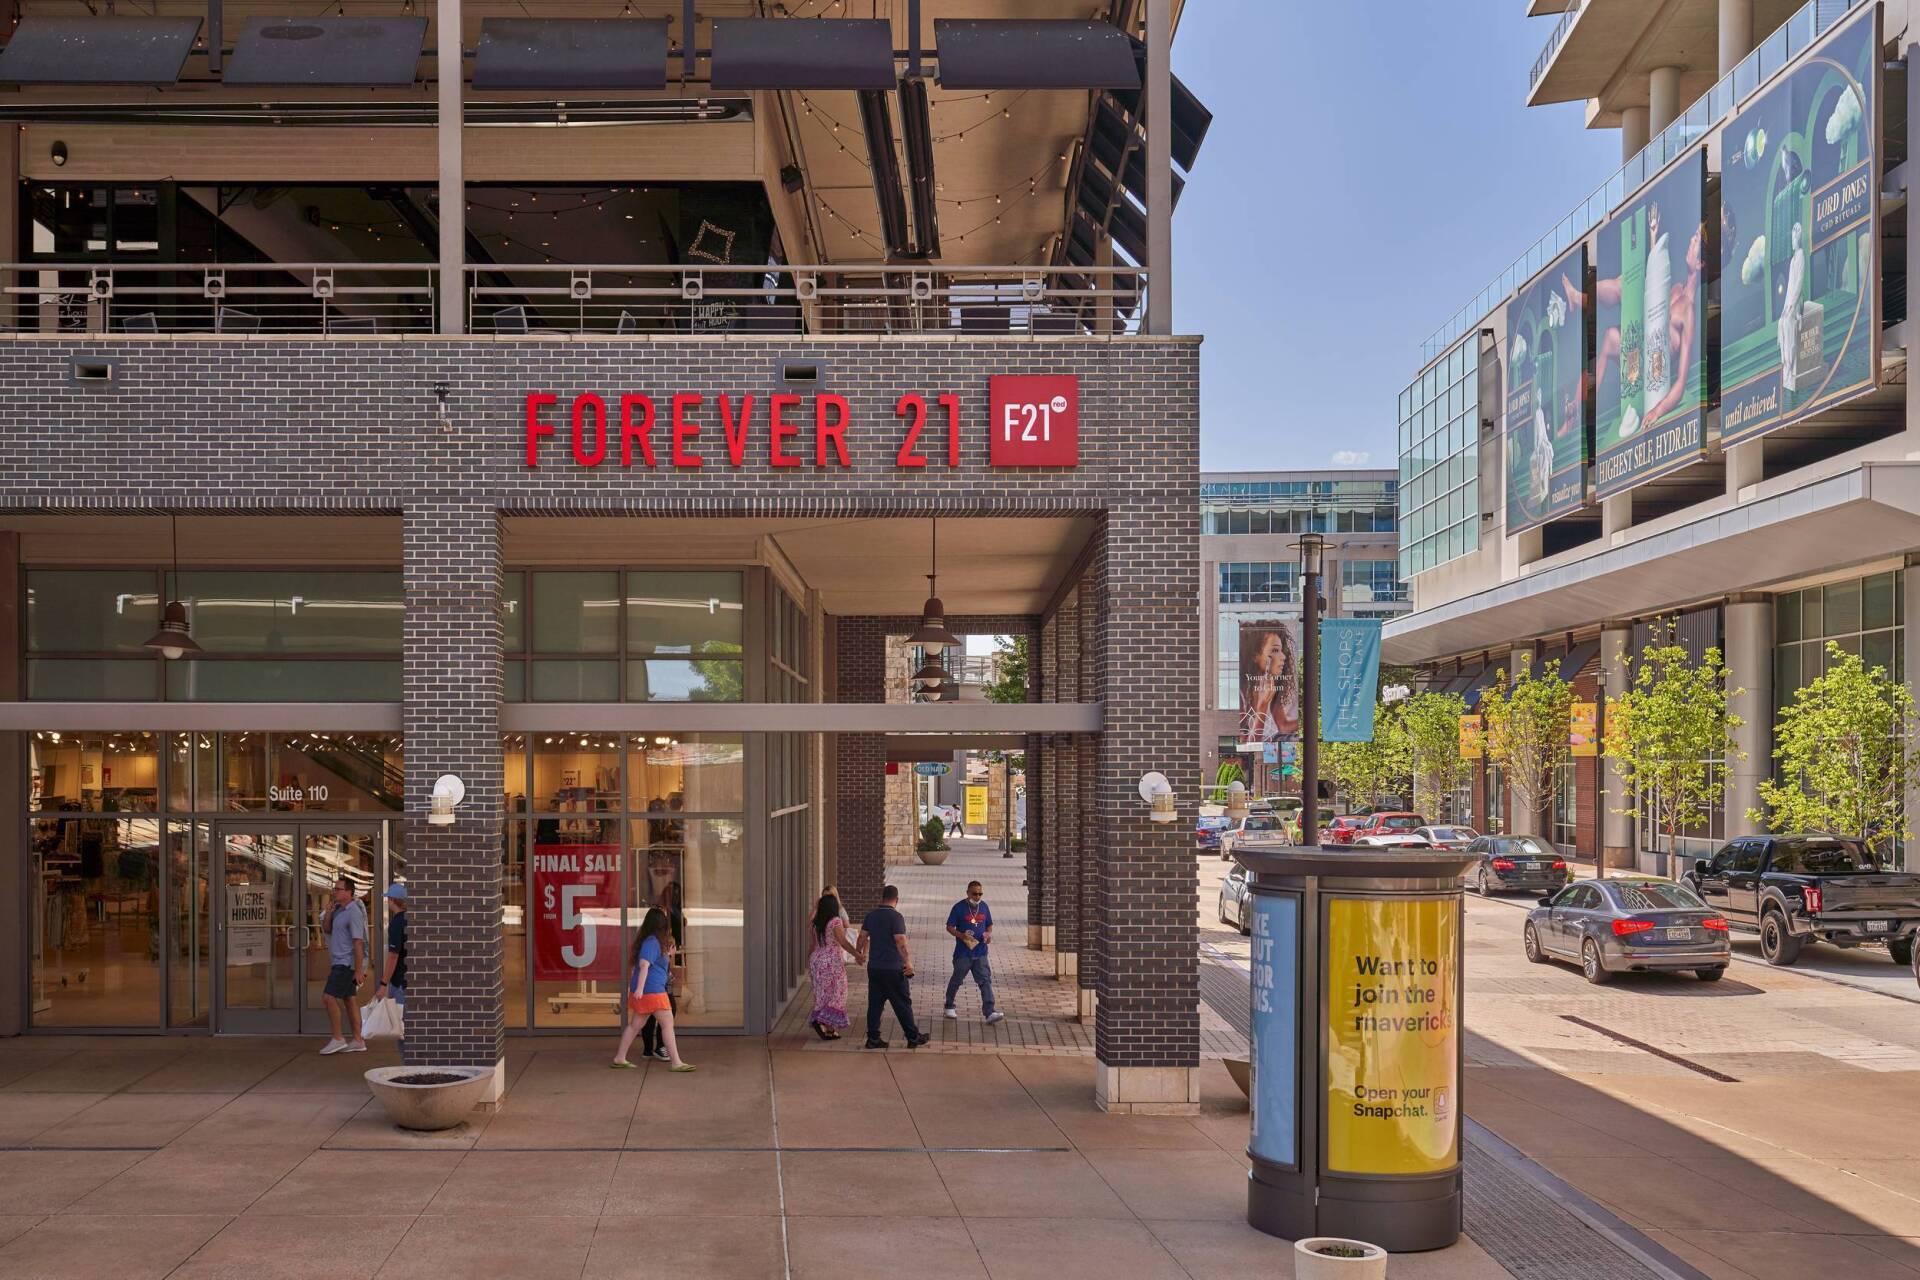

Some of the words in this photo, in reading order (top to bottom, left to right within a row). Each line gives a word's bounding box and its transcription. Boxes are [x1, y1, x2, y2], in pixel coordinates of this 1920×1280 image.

[1817, 192, 1840, 222] LORD
[1841, 174, 1867, 211] JONES
[1725, 401, 1743, 430] until
[1743, 386, 1777, 422] achieved.
[526, 393, 852, 468] FOREVER
[896, 393, 960, 468] 21
[1004, 403, 1050, 441] F21
[1599, 449, 1633, 485] HIGHEST
[1655, 418, 1699, 460] HYDRATE
[1354, 630, 1364, 665] LANE
[1338, 628, 1352, 690] SHOPS
[1245, 673, 1263, 681] Your
[1264, 673, 1293, 681] Corner
[1263, 683, 1284, 691] Glam
[1353, 672, 1362, 706] PARK
[1337, 696, 1350, 729] THE
[917, 765, 930, 773] OLD
[930, 765, 947, 773] NAVY
[269, 785, 303, 801] Suite
[308, 785, 328, 801] 110
[534, 855, 580, 873] FINAL
[235, 892, 265, 906] WE'RE
[232, 907, 267, 921] HIRING!
[1356, 956, 1415, 976] Want
[1420, 958, 1437, 976] to
[1354, 983, 1399, 1007] join
[1405, 984, 1435, 1003] the
[1354, 1085, 1397, 1101] Open
[1402, 1087, 1430, 1102] your
[1354, 1103, 1428, 1120] Snapchat.
